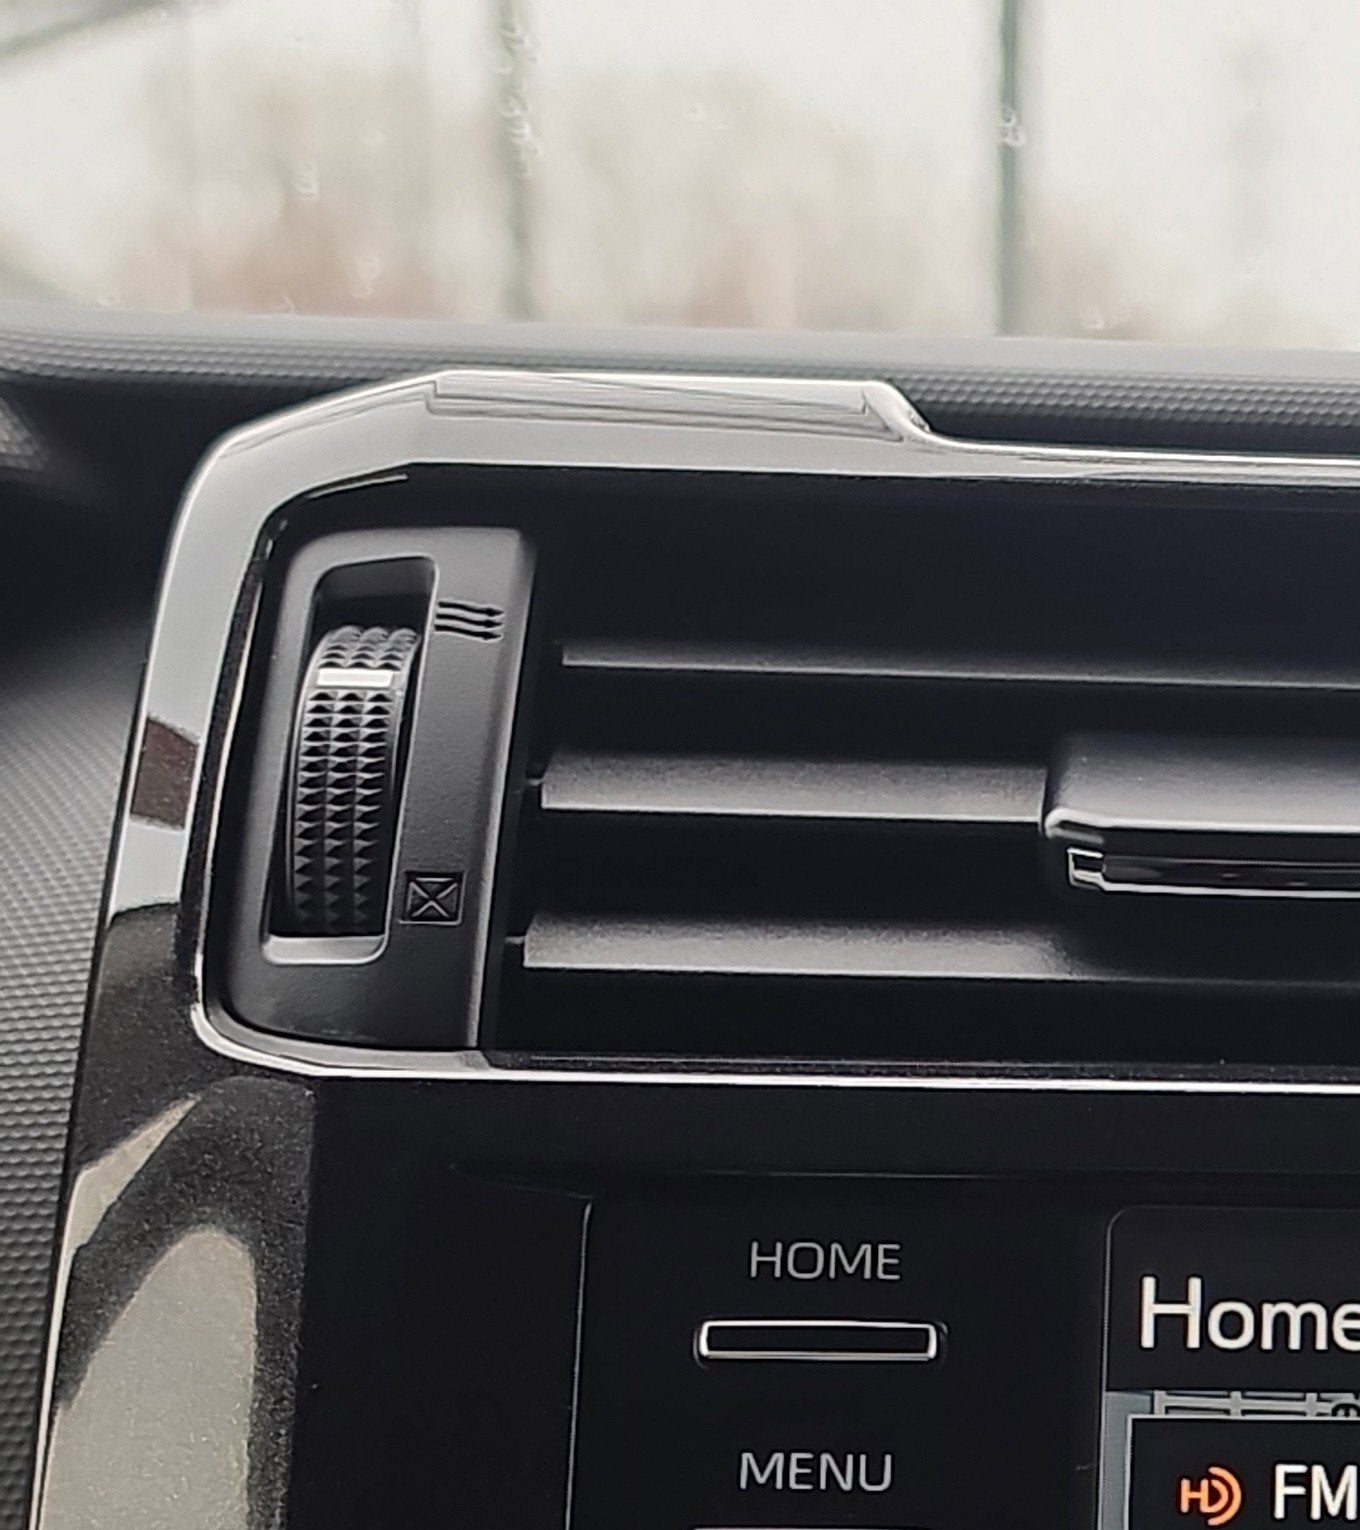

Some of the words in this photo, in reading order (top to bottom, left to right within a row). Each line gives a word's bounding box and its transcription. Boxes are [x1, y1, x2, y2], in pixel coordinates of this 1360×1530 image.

[751, 1242, 900, 1279] HOME
[740, 1453, 892, 1491] MENU
[1274, 1463, 1358, 1521] FM
